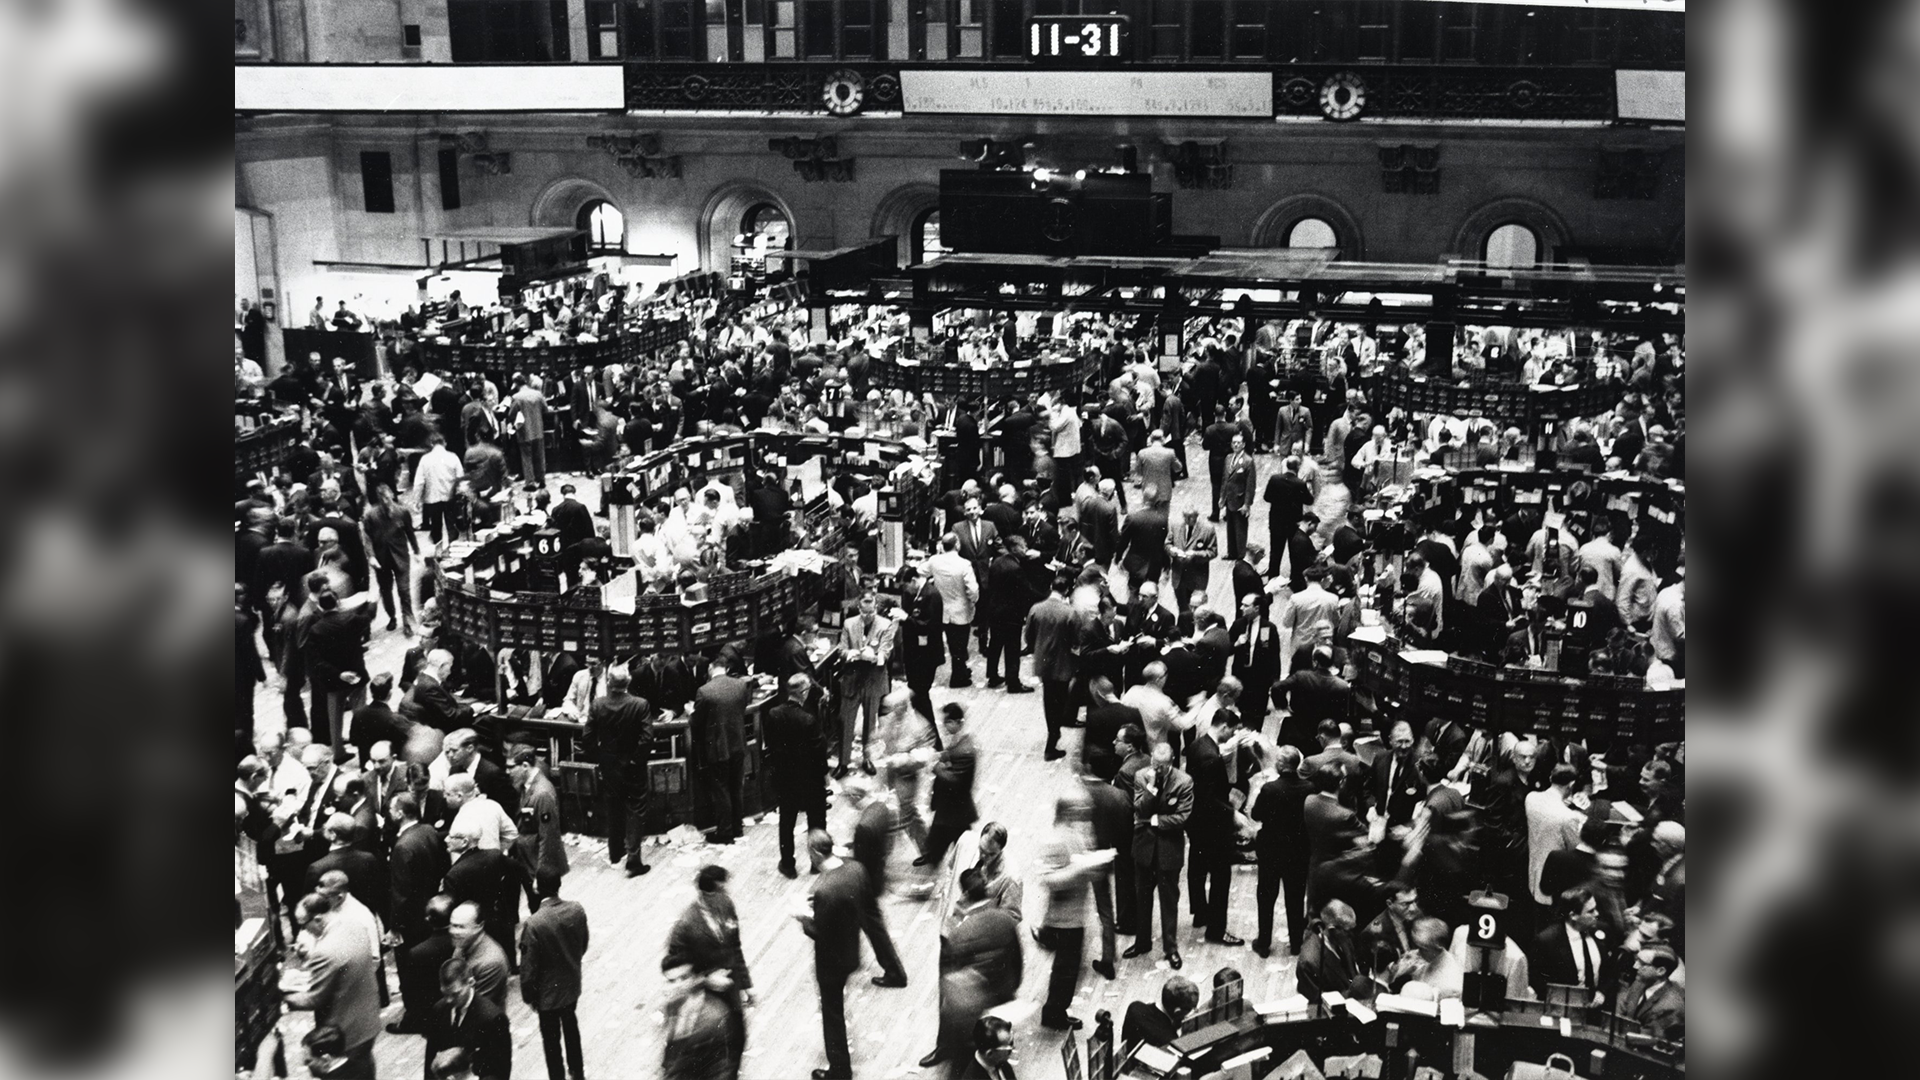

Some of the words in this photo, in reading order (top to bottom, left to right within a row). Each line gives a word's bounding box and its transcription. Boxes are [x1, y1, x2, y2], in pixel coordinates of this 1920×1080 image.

[1031, 23, 1119, 56] 11-31
[828, 388, 836, 400] 7
[538, 538, 549, 555] 6
[1572, 611, 1587, 629] 10
[1477, 913, 1496, 940] 9
